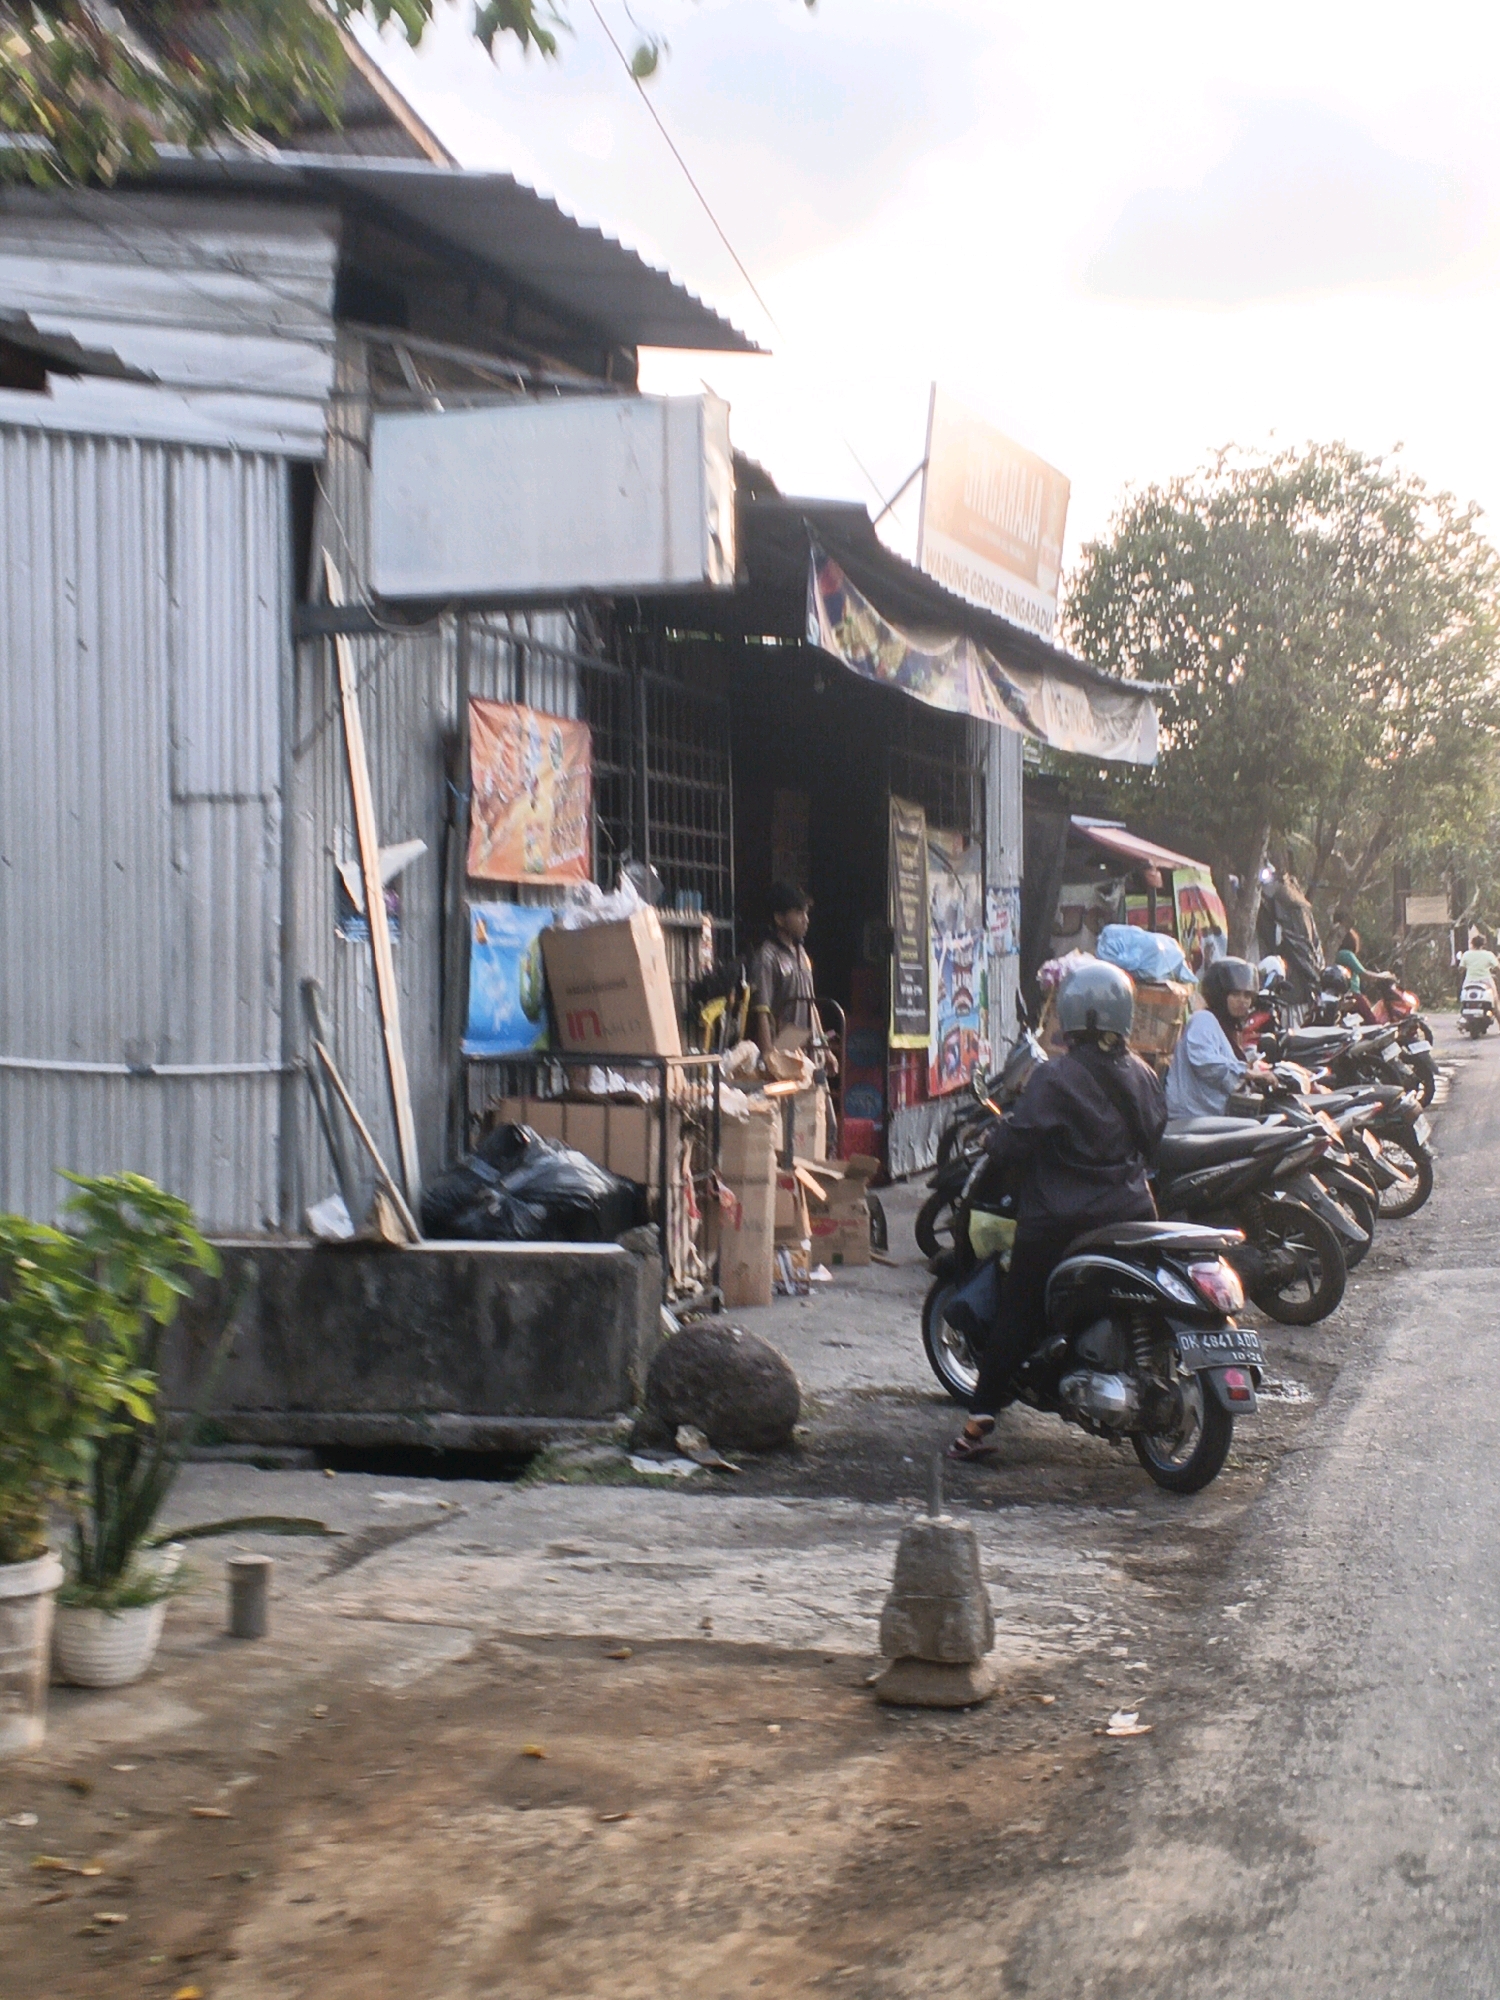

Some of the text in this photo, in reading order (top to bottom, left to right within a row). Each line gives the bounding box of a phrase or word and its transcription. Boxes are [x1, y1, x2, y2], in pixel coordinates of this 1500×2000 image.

[926, 549, 1053, 635] WARUNG GROSIR SINGAPADU
[1180, 1335, 1200, 1351] DK
